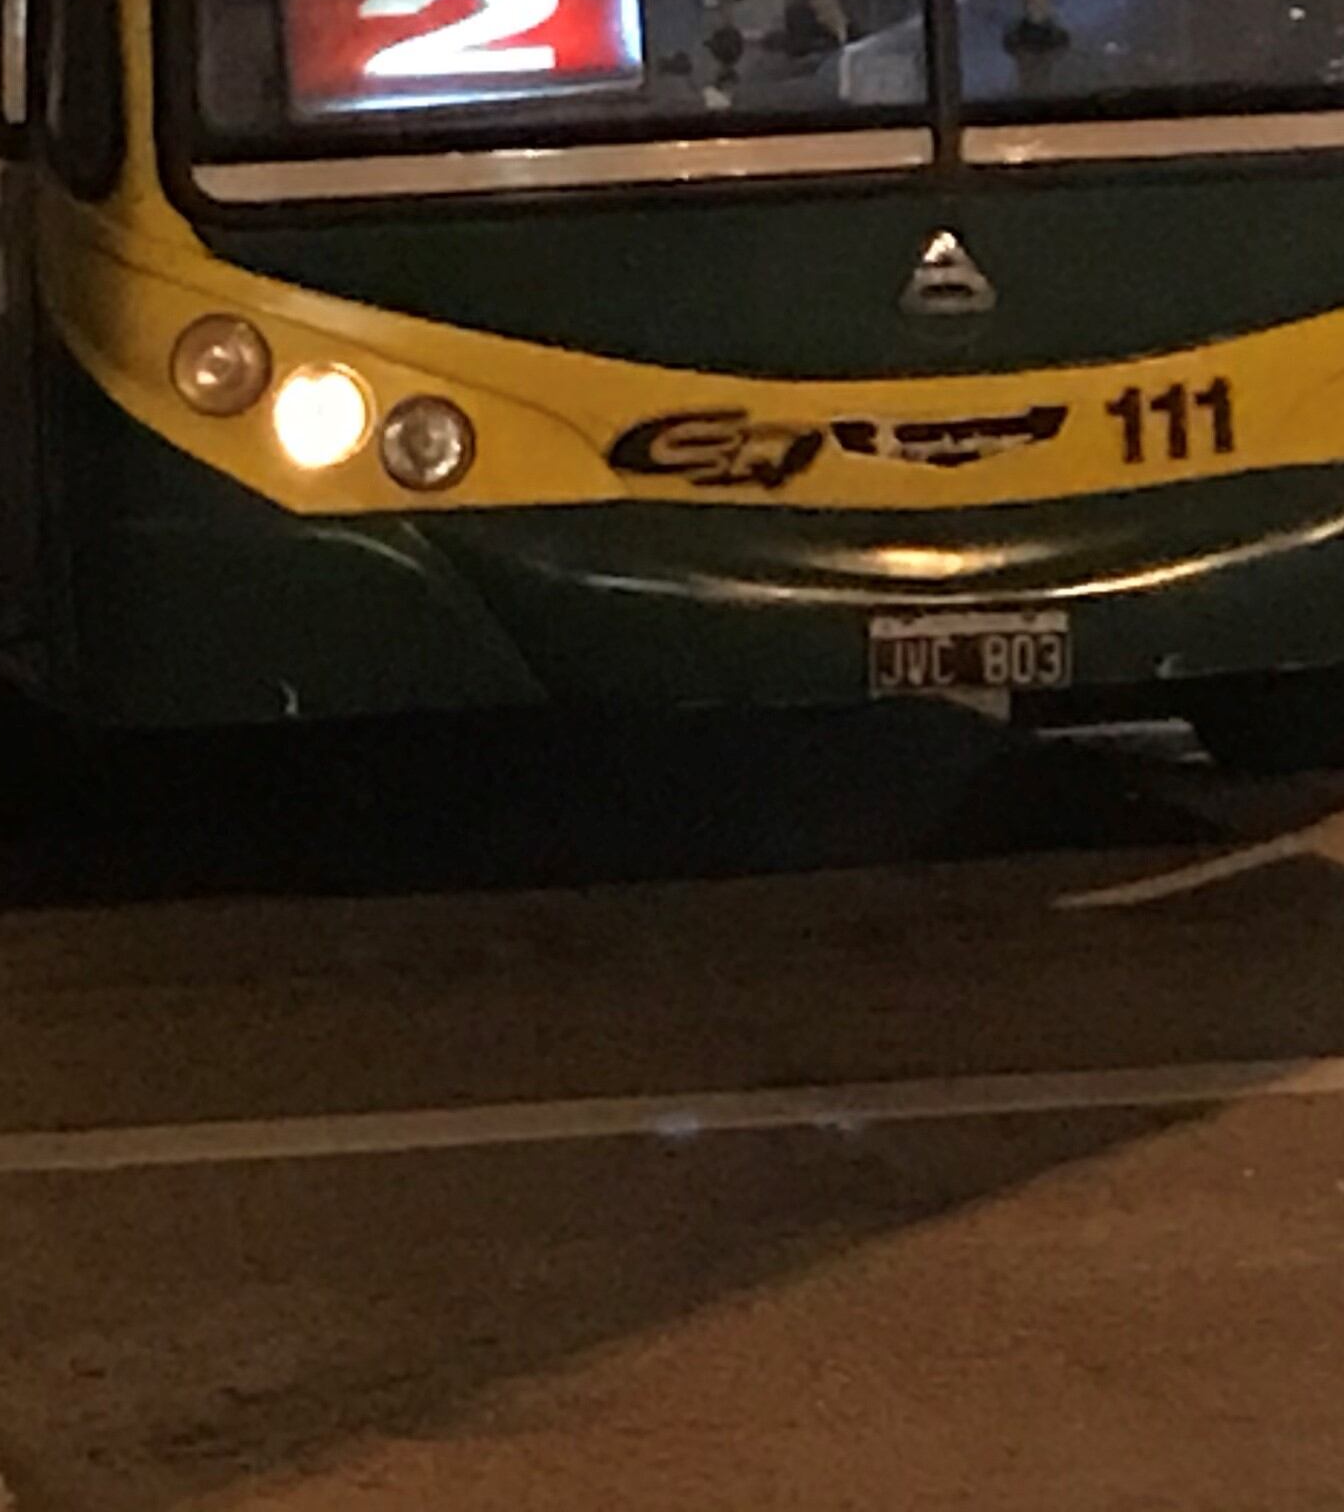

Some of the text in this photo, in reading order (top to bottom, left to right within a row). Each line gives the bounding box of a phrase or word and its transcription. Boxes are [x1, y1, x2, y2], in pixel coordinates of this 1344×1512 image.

[1105, 377, 1234, 463] 111
[880, 634, 1064, 686] JVC 803
